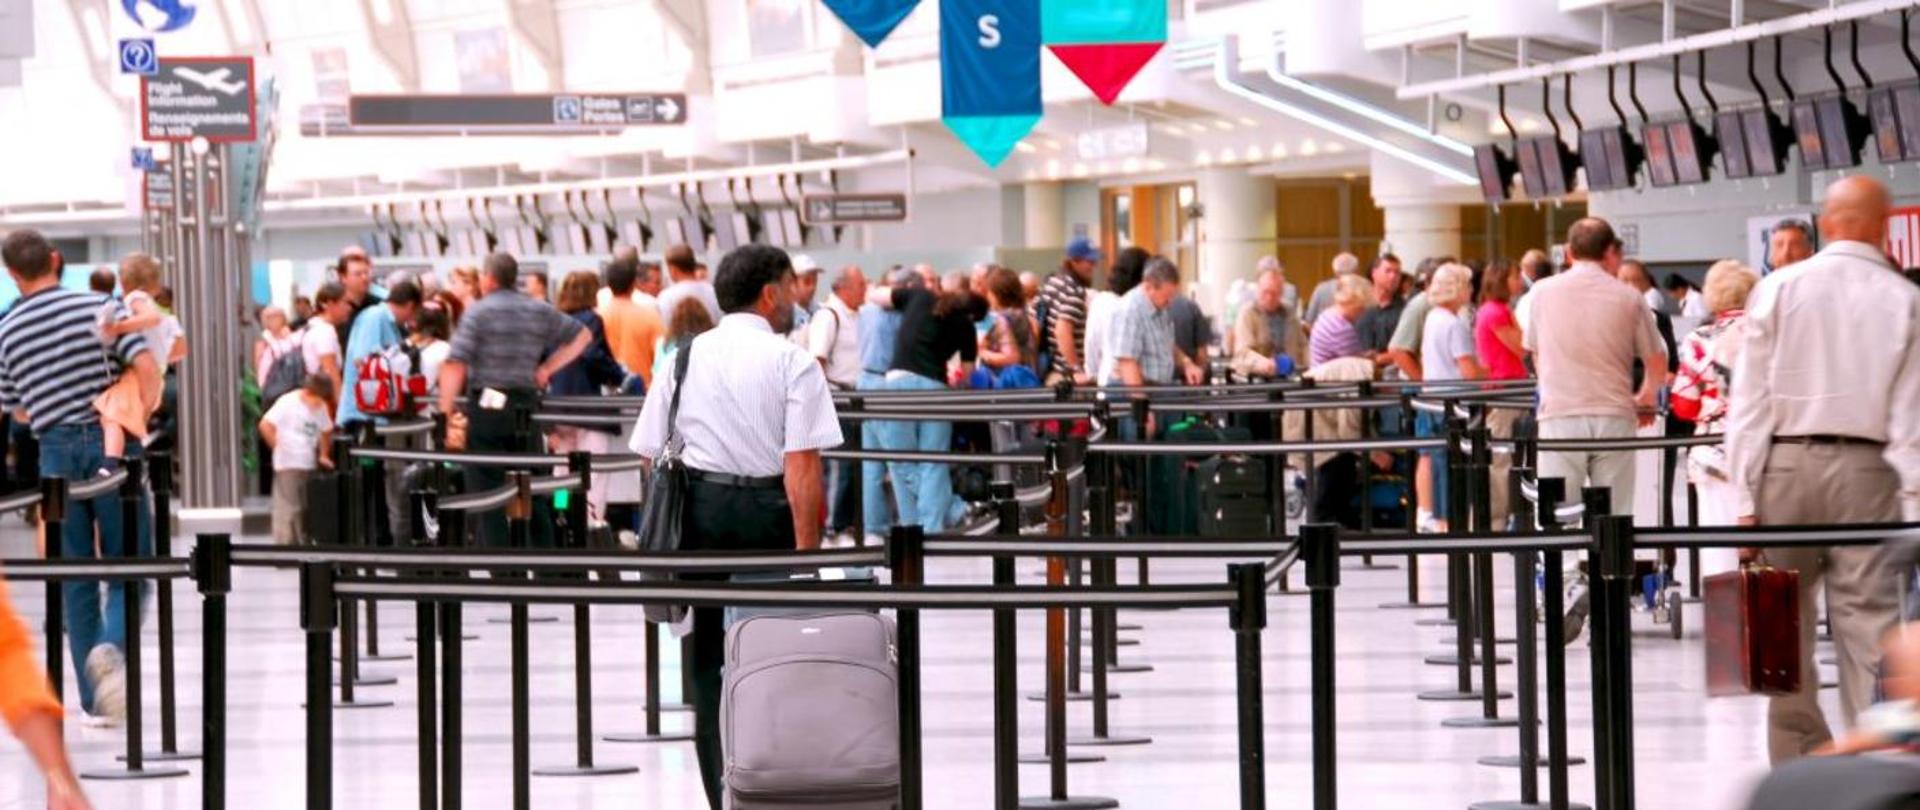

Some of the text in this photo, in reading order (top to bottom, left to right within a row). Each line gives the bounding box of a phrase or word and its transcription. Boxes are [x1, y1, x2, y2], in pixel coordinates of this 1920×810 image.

[979, 14, 1001, 48] S
[148, 82, 182, 97] Flight
[149, 95, 218, 107] Information
[149, 111, 249, 126] Renseignements
